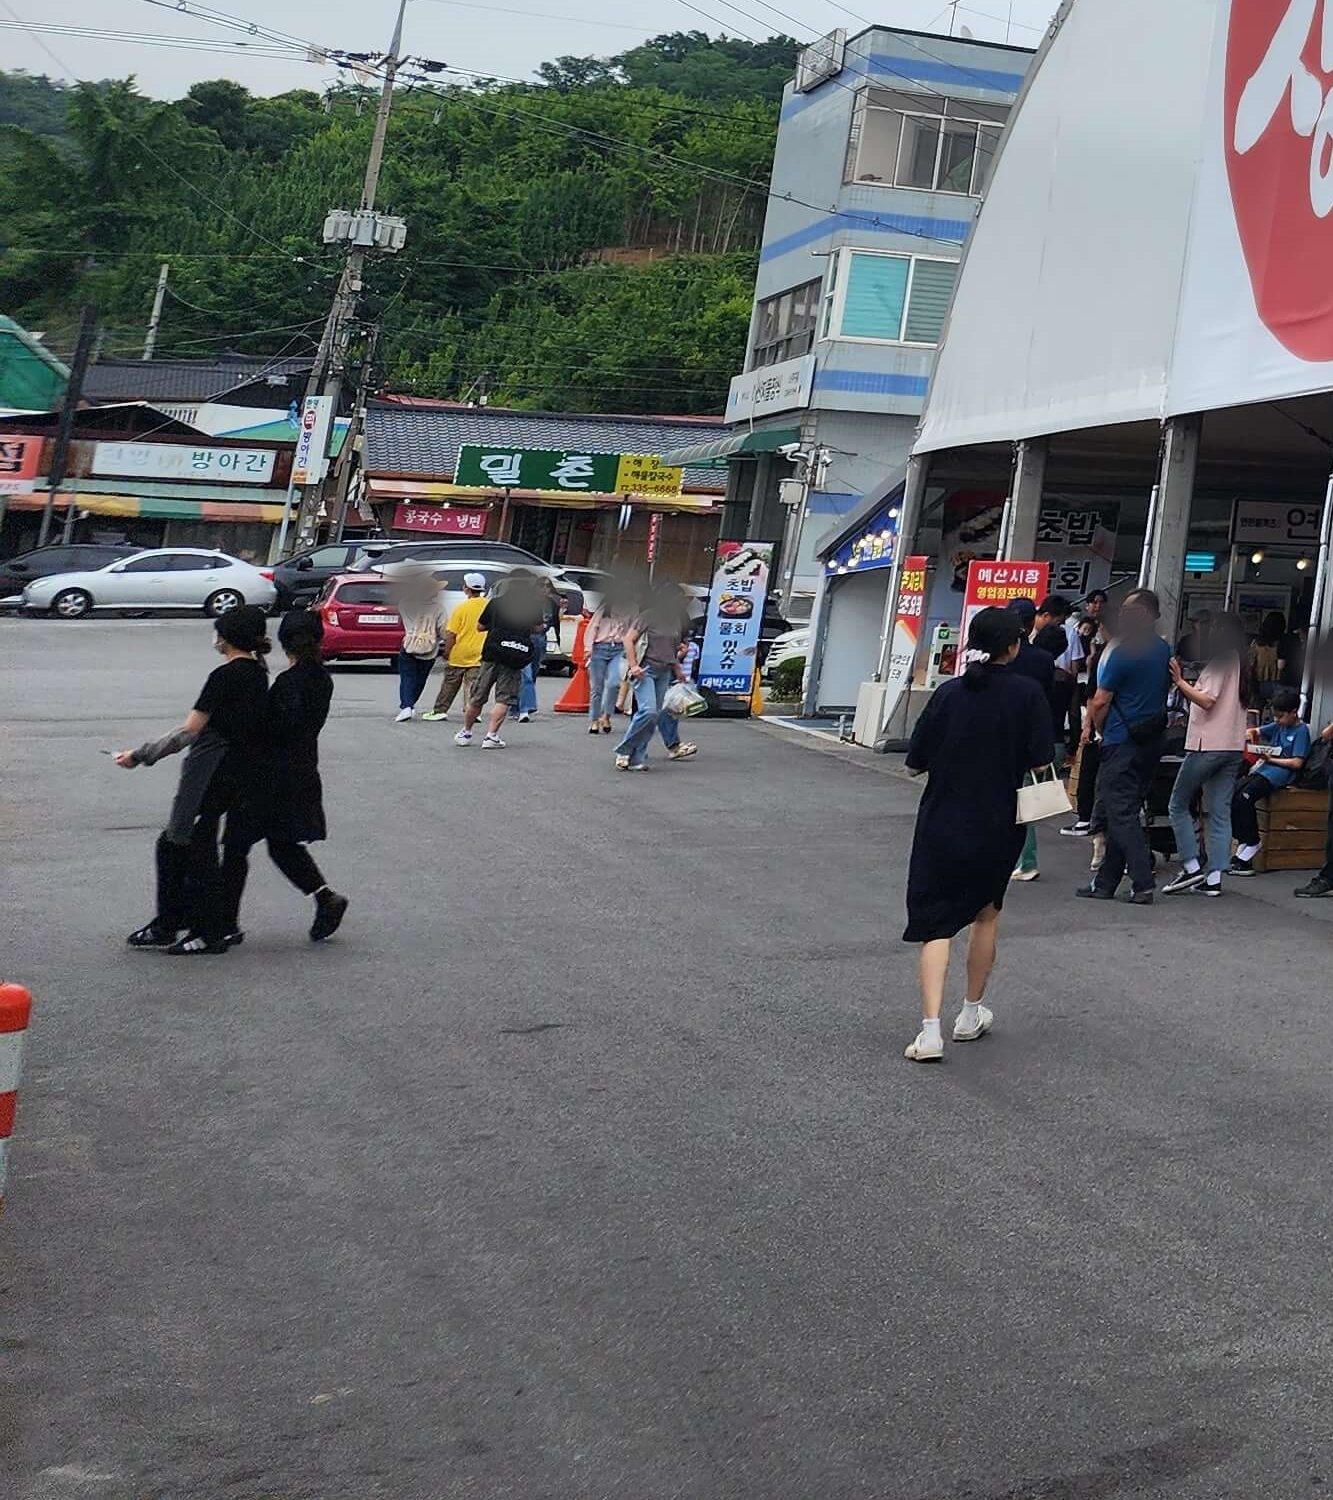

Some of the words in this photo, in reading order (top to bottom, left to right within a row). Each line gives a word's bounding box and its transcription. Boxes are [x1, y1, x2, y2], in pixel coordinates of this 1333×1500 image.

[192, 451, 267, 473] 방아간
[456, 512, 481, 529] 냉면
[1037, 509, 1099, 546] 초밥
[977, 567, 1041, 584] 예산시장
[726, 578, 754, 593] 초밥
[976, 586, 1037, 600] 영업점포안내
[719, 621, 748, 637] 물회
[500, 639, 529, 653] adidas
[701, 676, 746, 689] 대박수산
